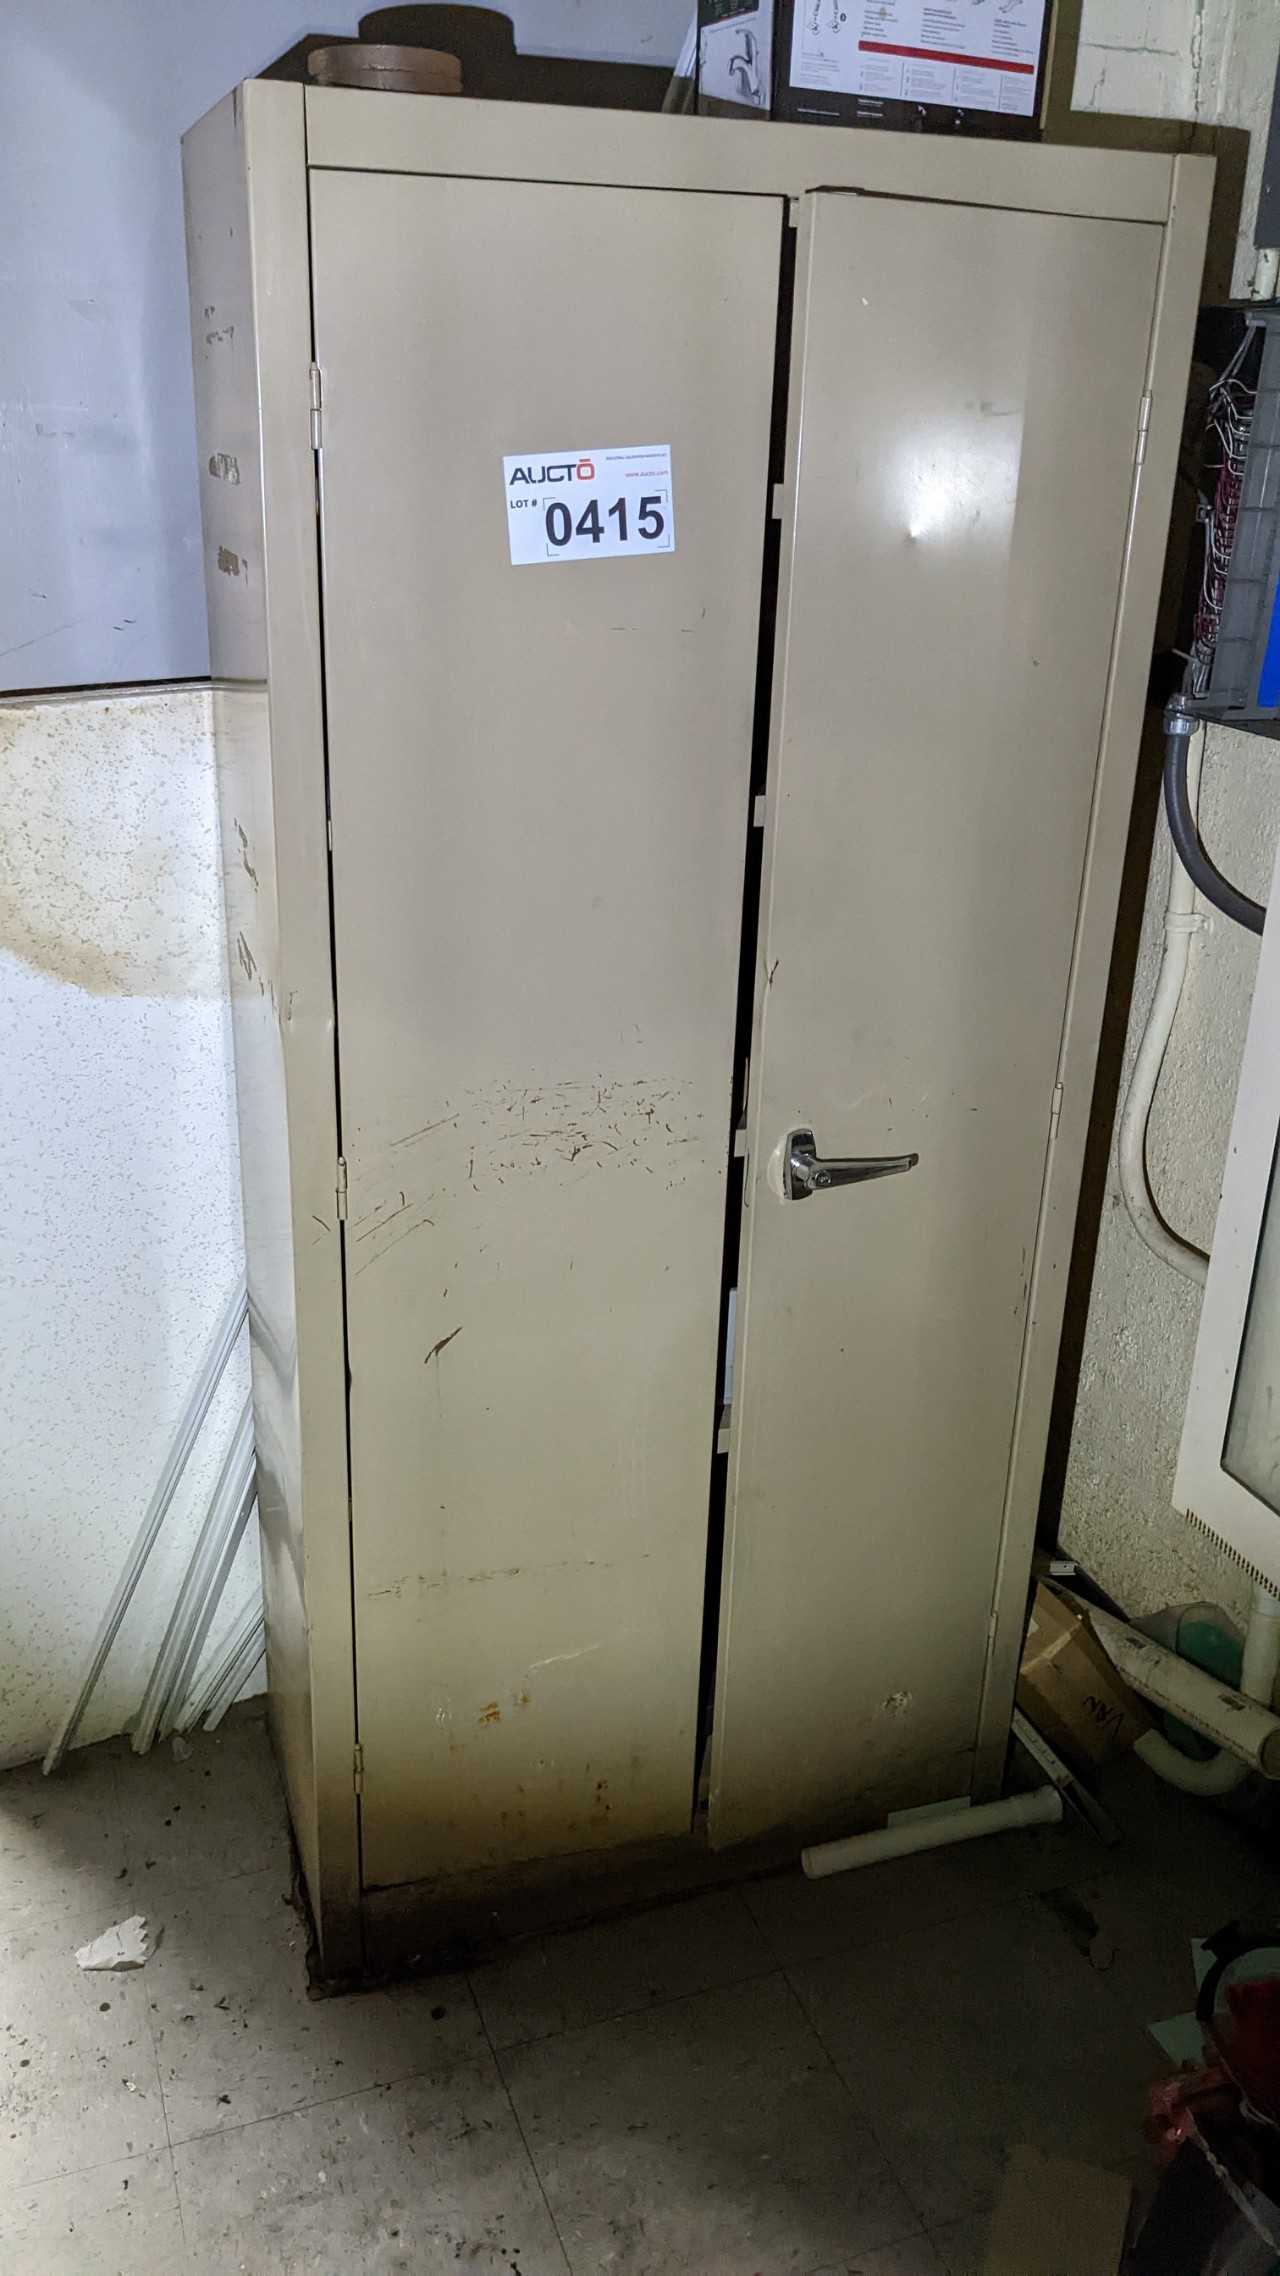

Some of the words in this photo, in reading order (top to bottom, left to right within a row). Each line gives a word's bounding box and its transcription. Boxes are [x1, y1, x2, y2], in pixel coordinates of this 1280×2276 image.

[510, 499, 529, 509] LOT
[531, 499, 538, 507] #
[545, 496, 664, 546] 0415
